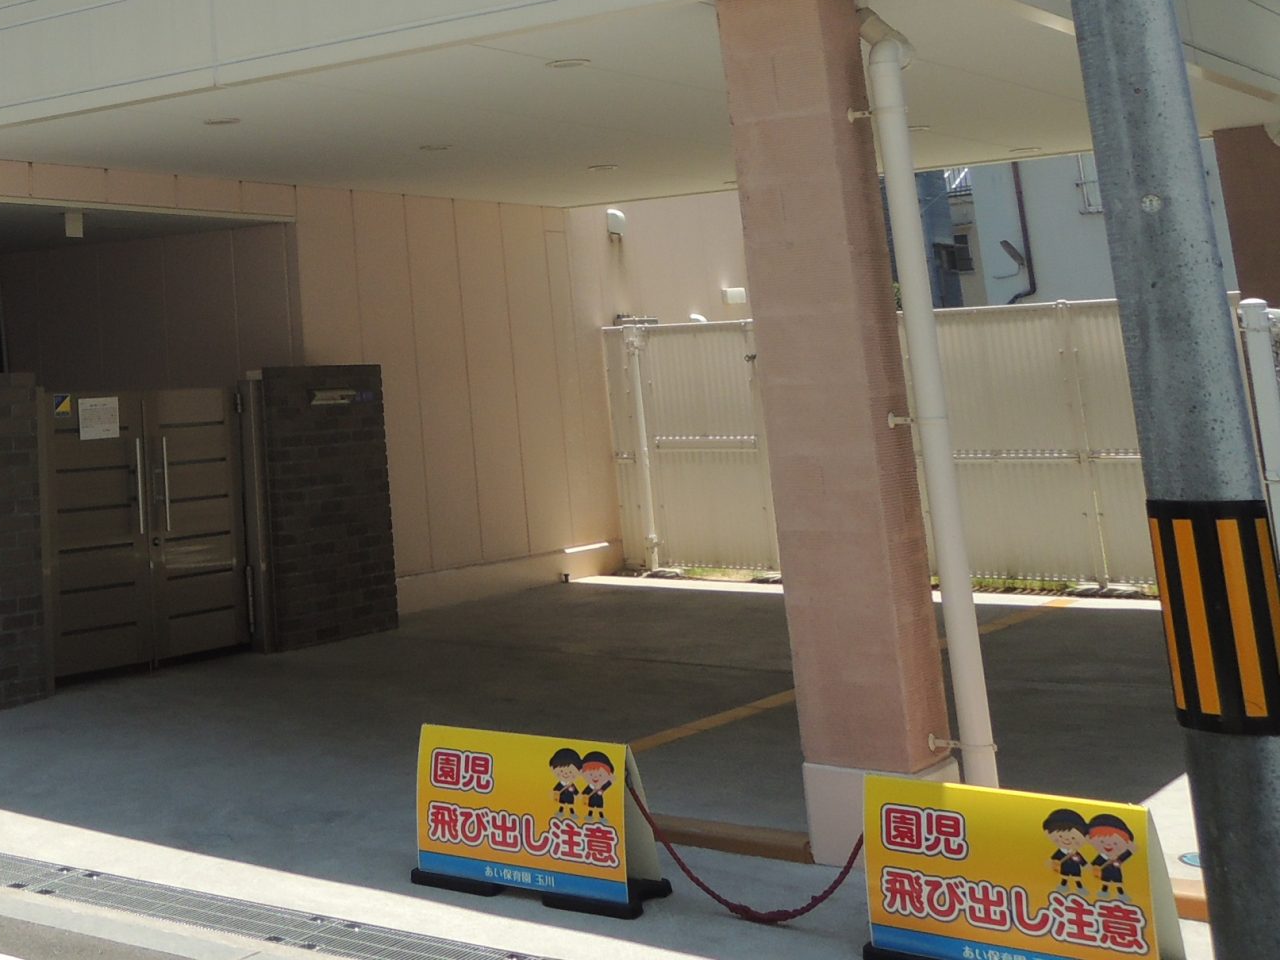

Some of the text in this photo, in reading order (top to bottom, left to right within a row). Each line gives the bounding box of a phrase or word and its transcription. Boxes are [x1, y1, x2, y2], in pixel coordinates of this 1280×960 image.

[431, 748, 493, 792] 園児
[428, 801, 620, 867] 飛び出し注意
[882, 804, 968, 860] 園児
[484, 865, 555, 888] あい保育園 玉川
[881, 866, 1149, 955] 飛び出し注意
